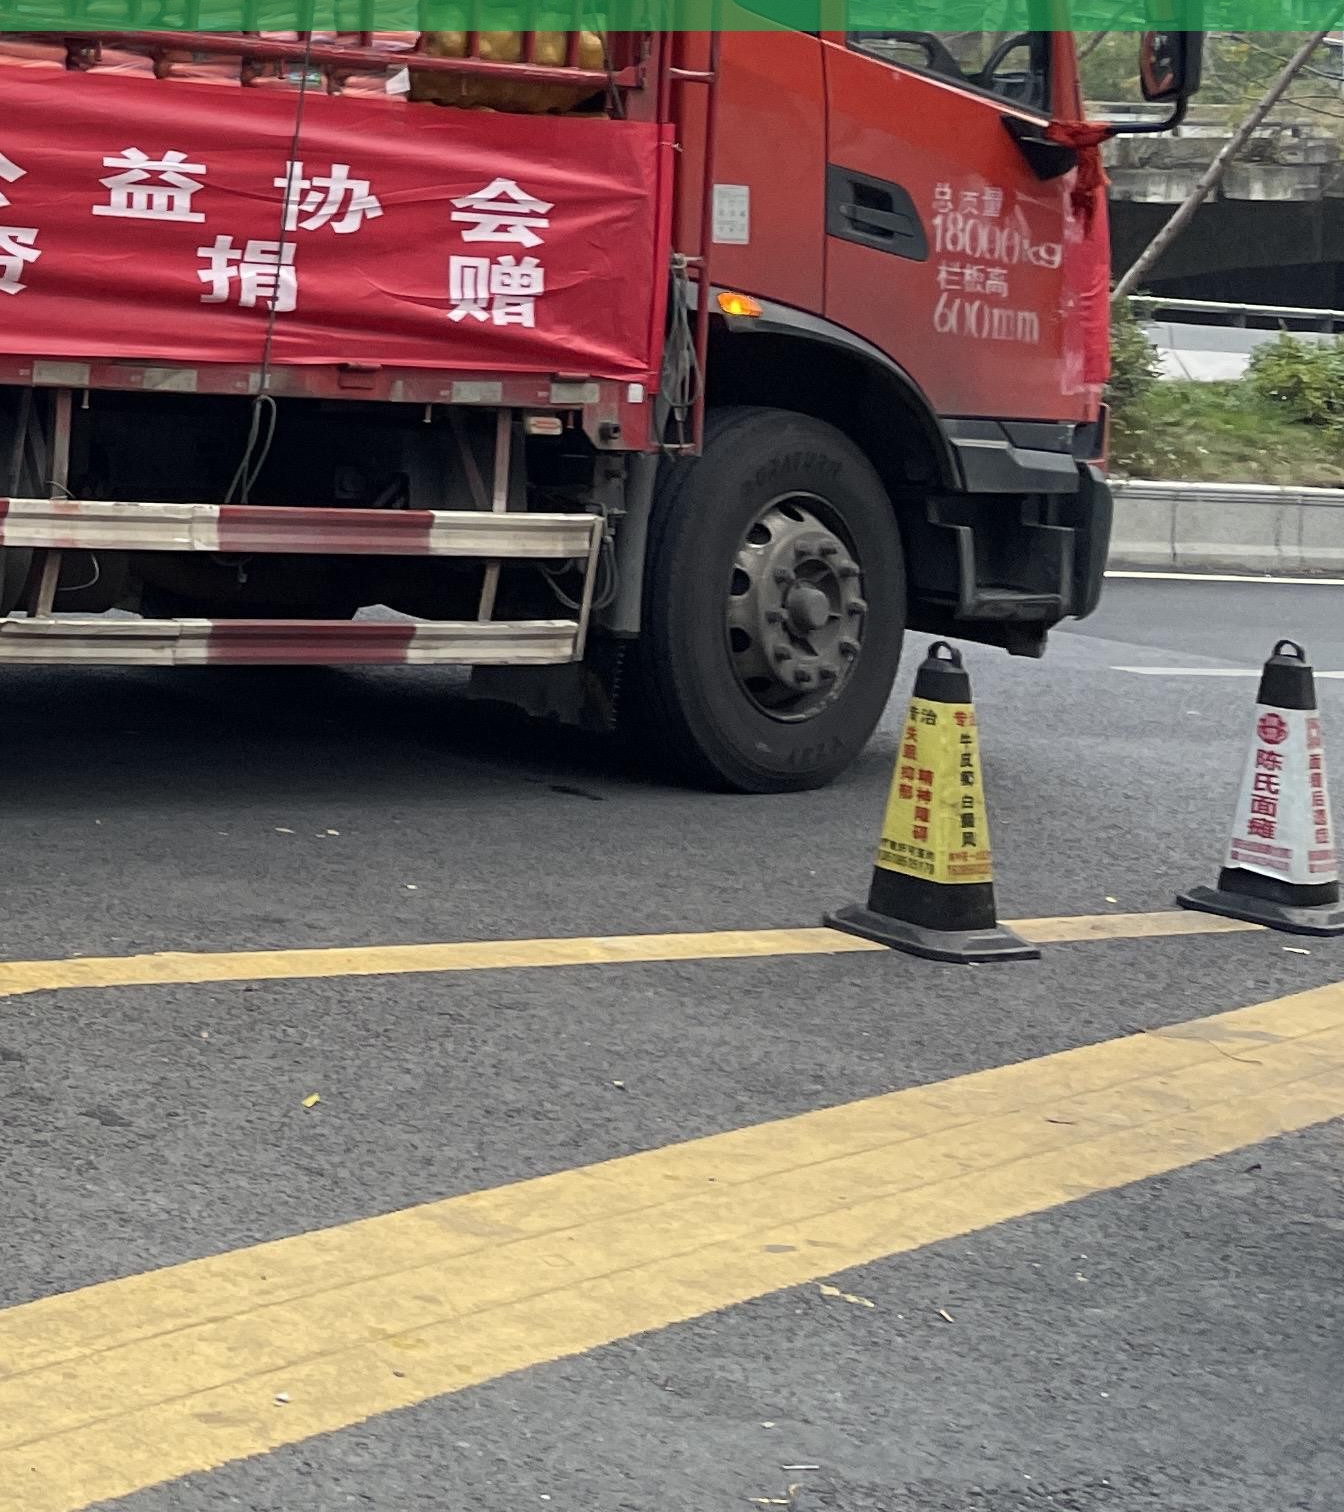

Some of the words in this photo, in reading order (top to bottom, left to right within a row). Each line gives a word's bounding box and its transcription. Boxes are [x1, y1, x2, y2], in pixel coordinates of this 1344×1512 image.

[936, 264, 1009, 298] 栏板高
[933, 292, 1040, 344] 600mm
